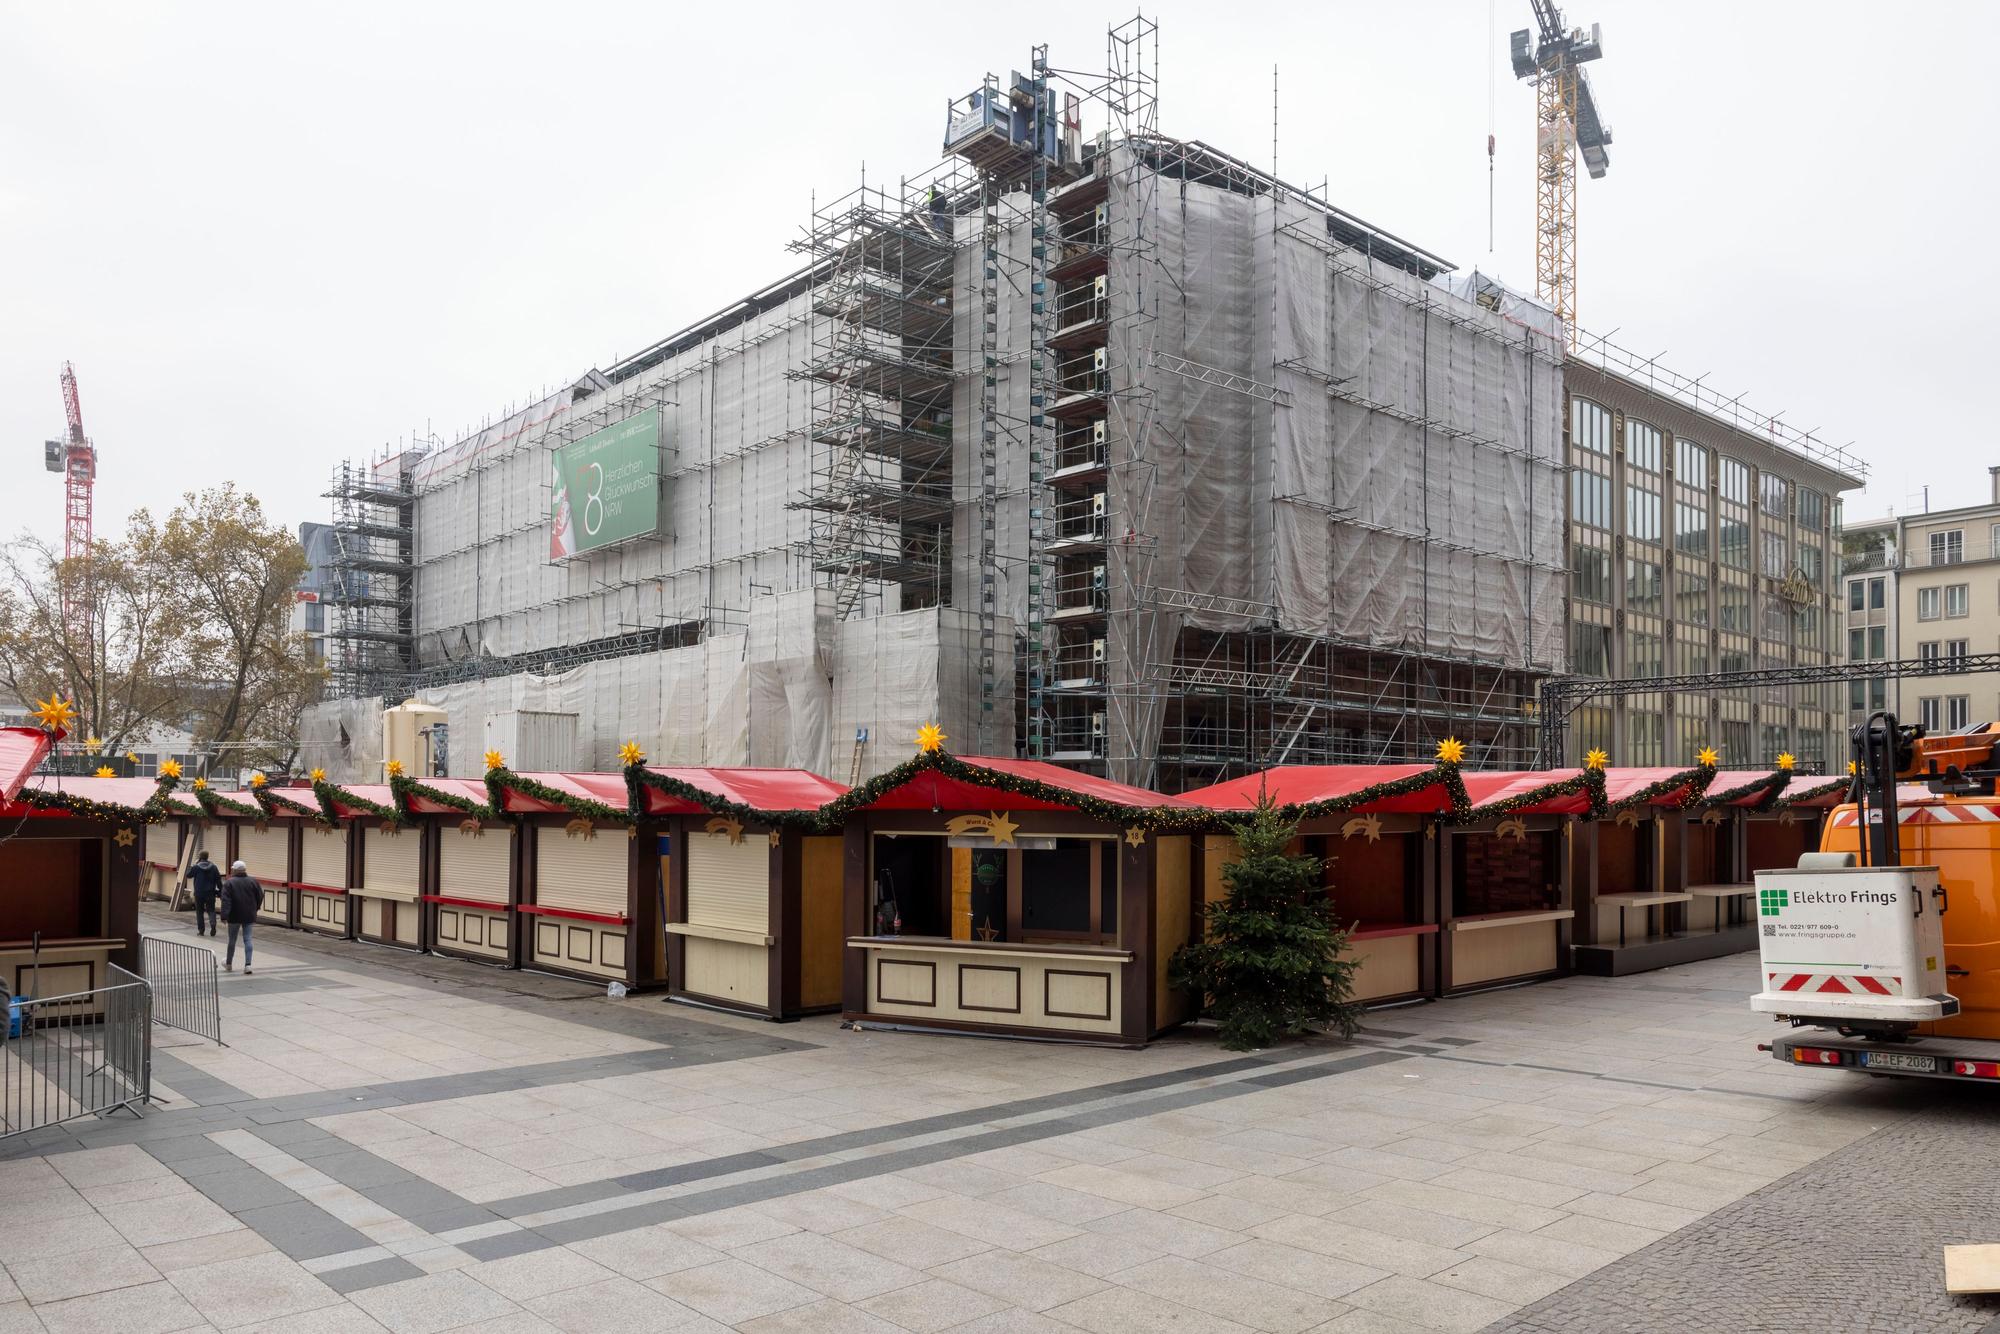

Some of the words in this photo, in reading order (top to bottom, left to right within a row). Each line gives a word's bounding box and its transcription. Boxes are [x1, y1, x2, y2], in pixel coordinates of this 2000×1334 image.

[604, 459, 643, 483] Herzlichen
[604, 471, 653, 501] Glückwunsch
[604, 500, 623, 519] NRW
[1131, 832, 1139, 840] 18
[1793, 890, 1847, 904] Elektro
[1851, 890, 1897, 906] Frings
[1778, 931, 1857, 939] www.fringsgruppe.de
[1868, 1053, 1882, 1064] AC
[1889, 1055, 1904, 1066] EF
[1906, 1056, 1934, 1068] 2087
